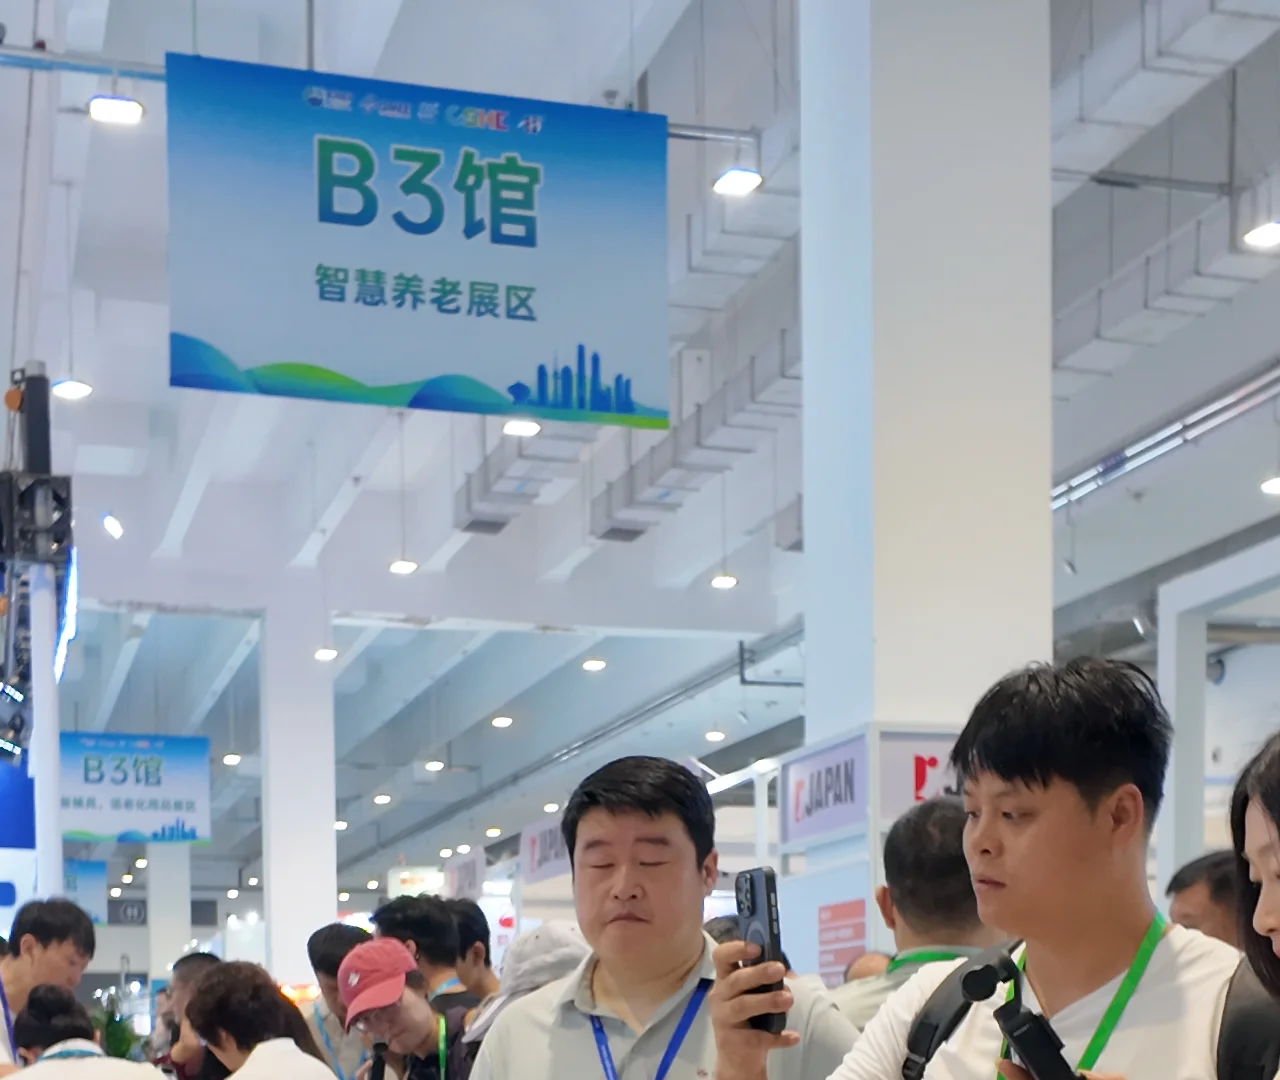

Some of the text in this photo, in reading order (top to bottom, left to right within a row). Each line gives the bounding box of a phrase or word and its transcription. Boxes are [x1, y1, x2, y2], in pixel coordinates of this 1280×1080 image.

[314, 134, 544, 248] B3馆
[315, 264, 538, 322] 智慧养老展区
[83, 754, 163, 787] B3馆
[805, 758, 856, 818] JAPAN
